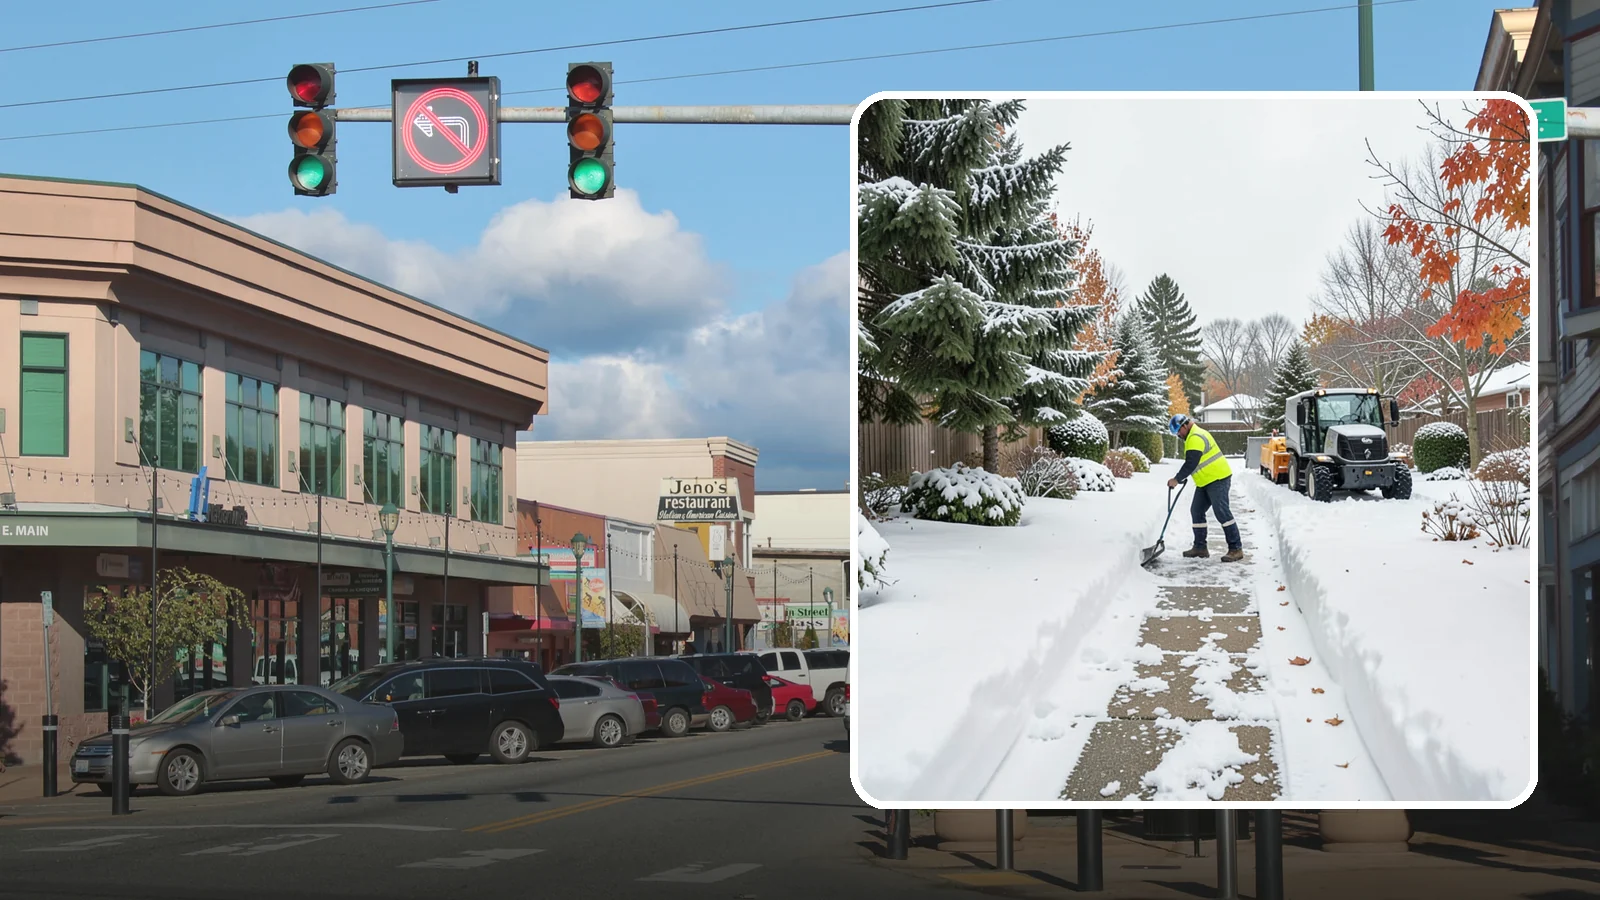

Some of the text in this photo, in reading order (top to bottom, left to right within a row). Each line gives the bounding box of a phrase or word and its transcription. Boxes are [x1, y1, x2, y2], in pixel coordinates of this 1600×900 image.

[669, 480, 728, 495] Jeno's
[665, 496, 731, 509] restaurant
[658, 510, 682, 520] Italian
[686, 510, 715, 519] American
[715, 509, 737, 519] Cuisine
[2, 525, 49, 536] E. MAIN
[797, 607, 829, 617] Street
[791, 619, 824, 627] lass
